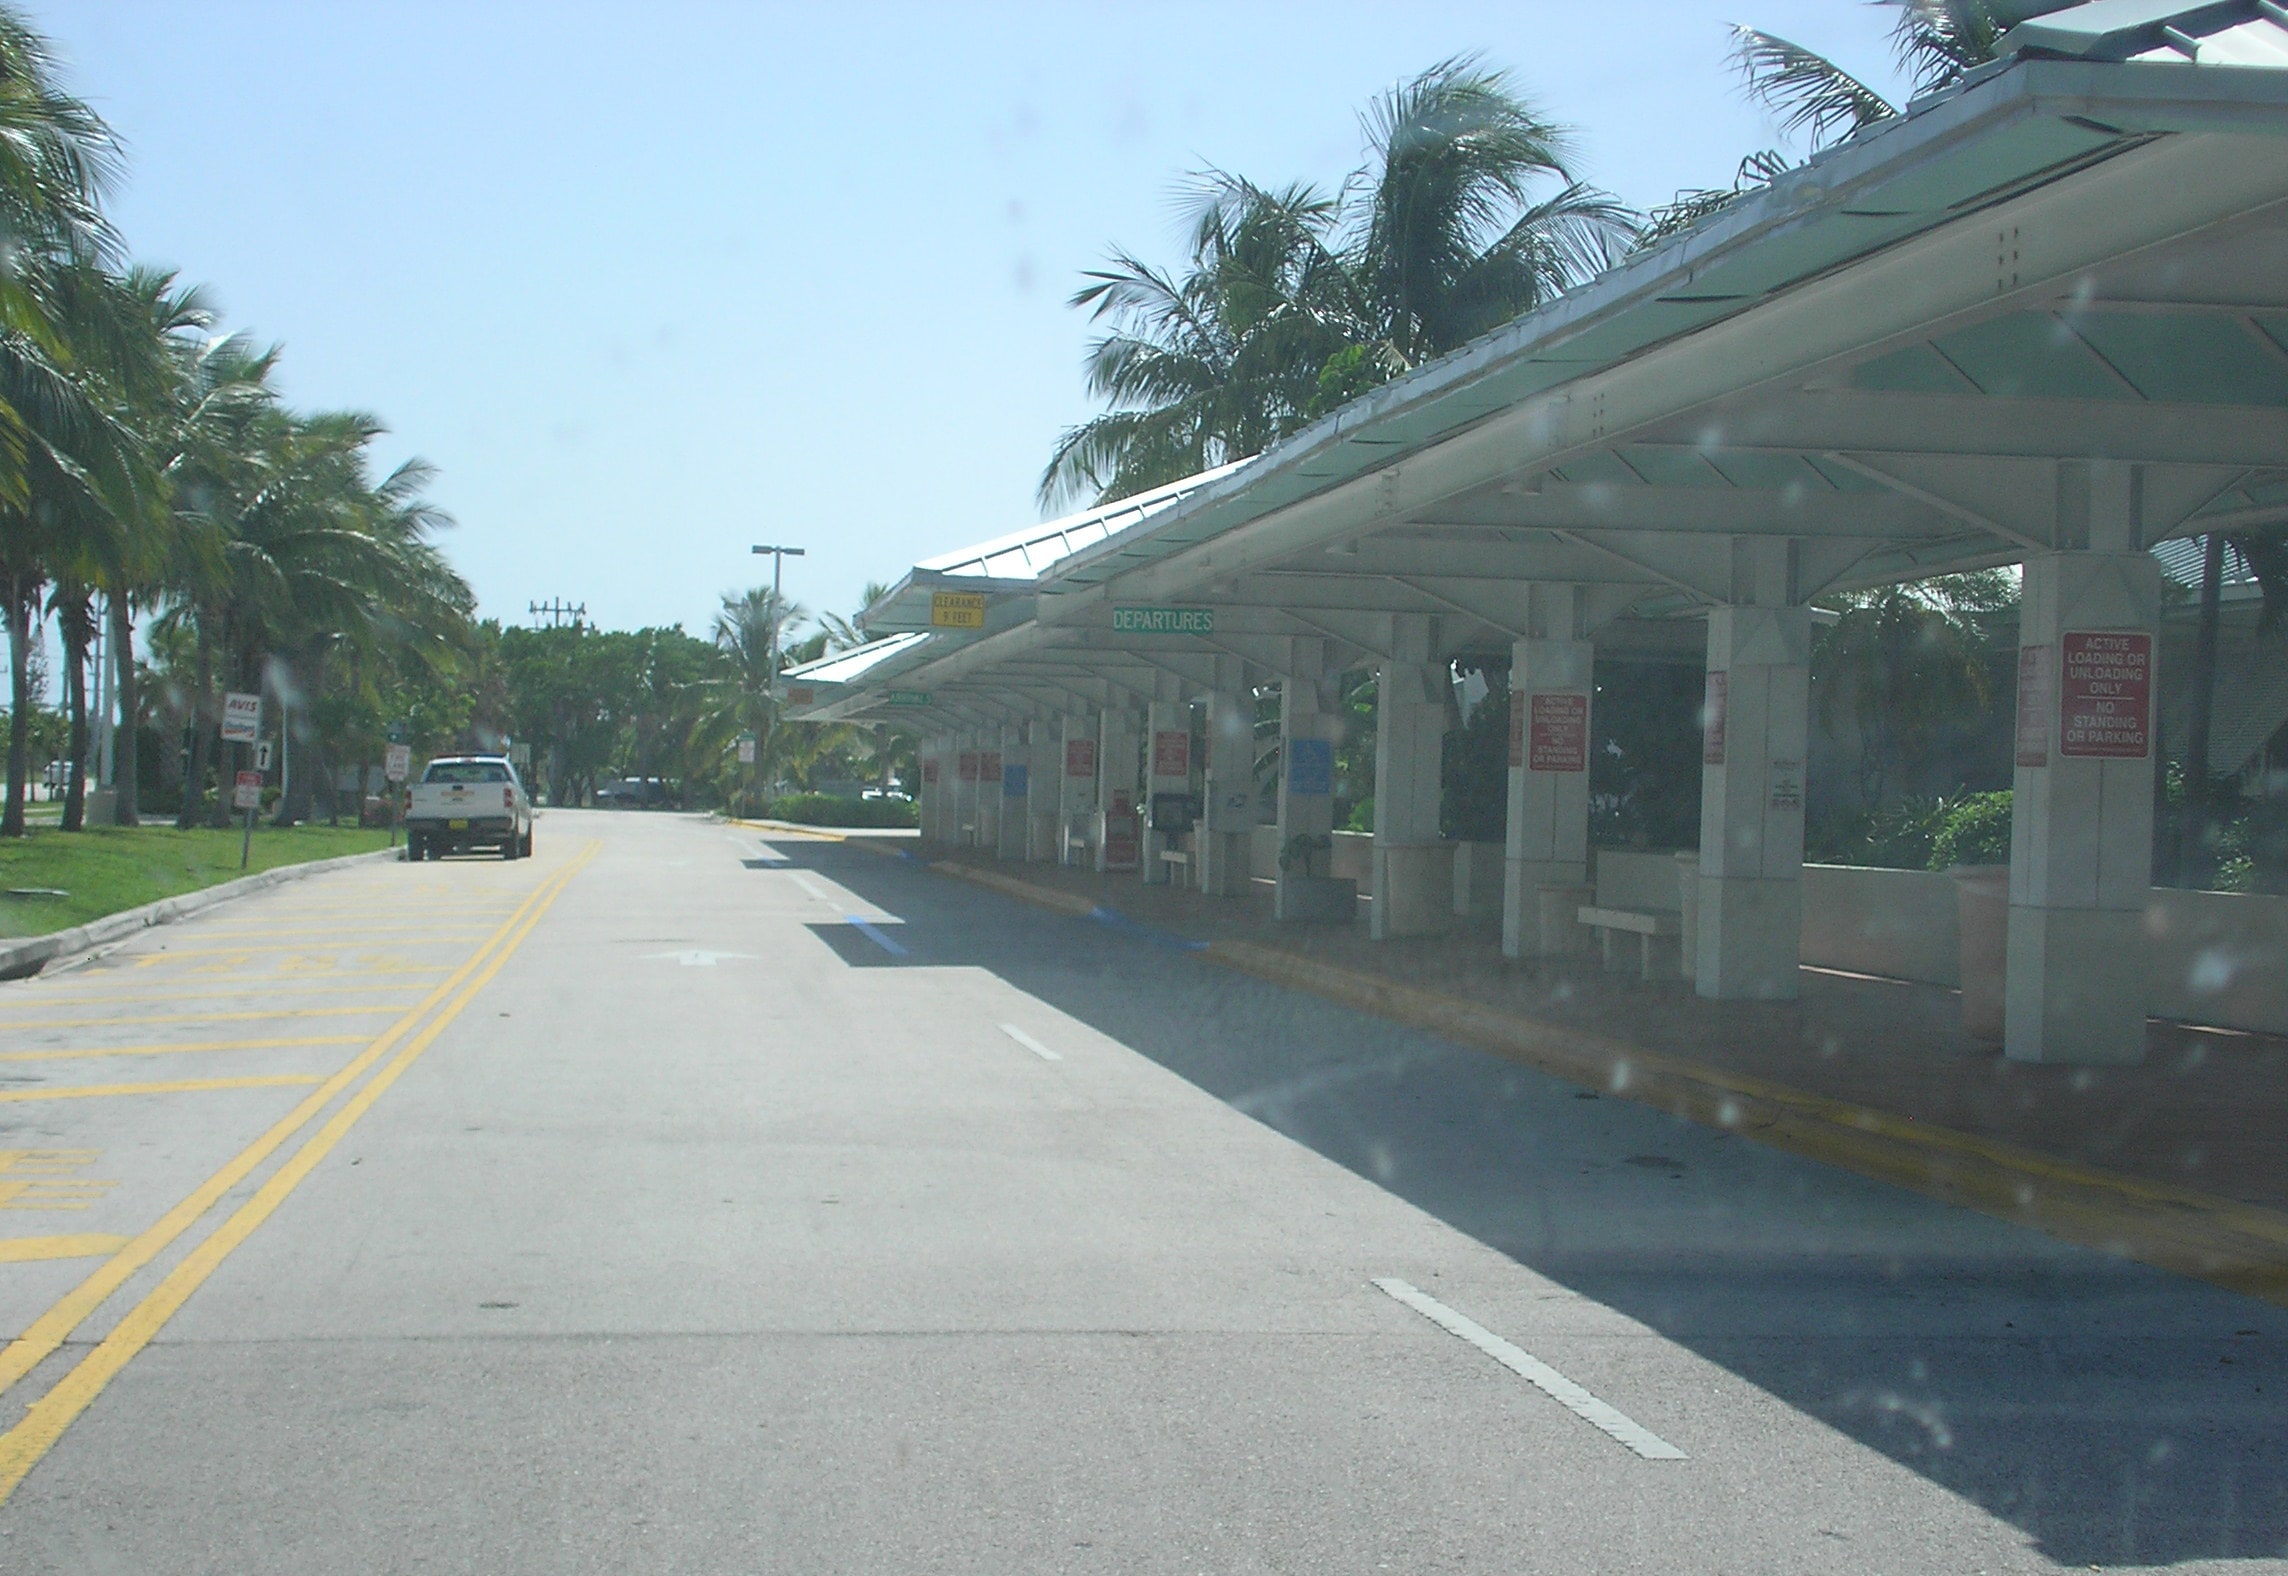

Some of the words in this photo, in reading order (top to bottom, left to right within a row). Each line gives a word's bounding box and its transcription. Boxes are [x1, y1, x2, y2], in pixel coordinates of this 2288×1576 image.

[934, 596, 982, 609] CLEARANCE
[1113, 611, 1213, 630] DEPARTURES
[2085, 638, 2130, 651] ACTIVE
[2068, 652, 2123, 665] LOADING
[2127, 653, 2146, 666] OR
[2070, 667, 2143, 680] UNLOADING
[2089, 682, 2123, 695] ONLY
[229, 699, 258, 712] AVIS
[2096, 701, 2115, 714] NO
[2074, 716, 2137, 729] STANDING
[2066, 730, 2085, 742] OR
[2088, 731, 2144, 744] PARKING
